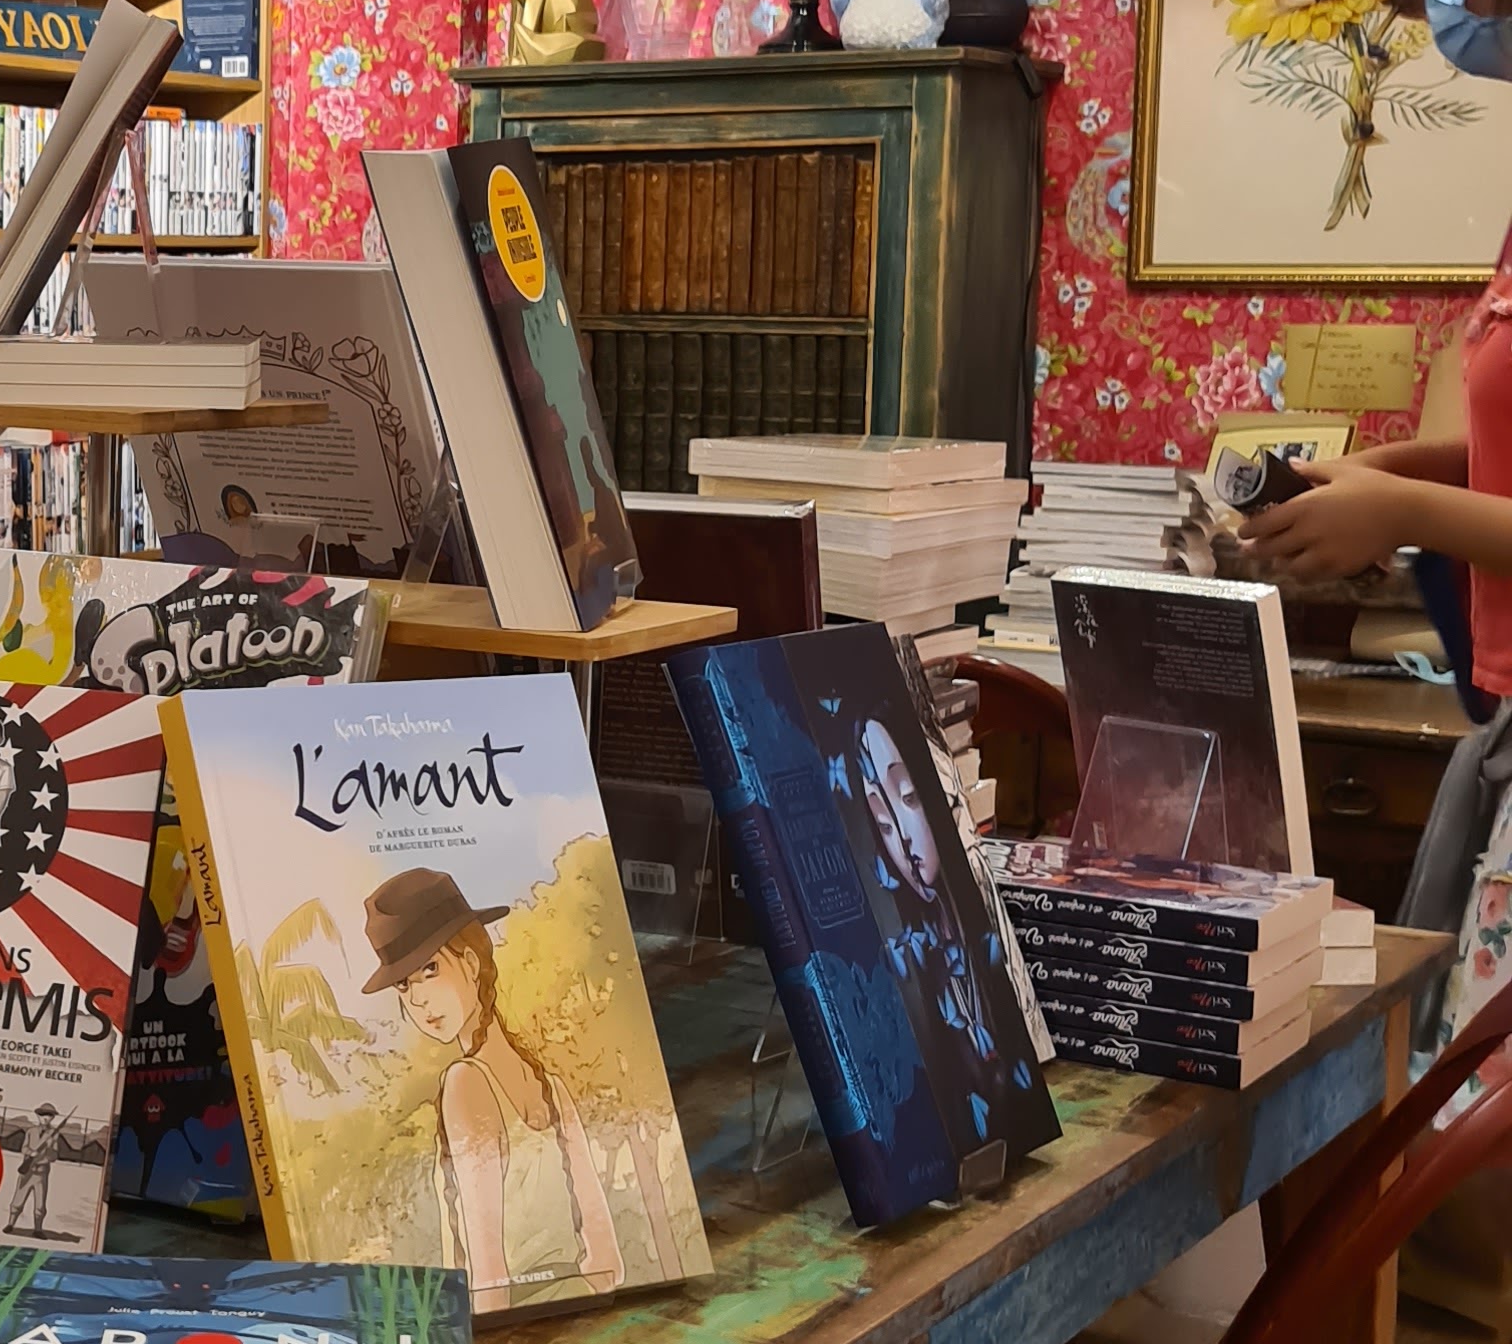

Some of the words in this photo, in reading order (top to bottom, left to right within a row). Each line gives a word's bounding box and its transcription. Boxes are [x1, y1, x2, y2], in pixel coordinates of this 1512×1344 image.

[165, 599, 196, 617] THE
[200, 594, 234, 608] ART
[238, 593, 259, 606] OF
[90, 604, 325, 696] Splatoon
[293, 732, 525, 833] L'amant
[418, 826, 429, 836] LE
[431, 824, 464, 836] ROMAN
[369, 844, 382, 853] DE
[384, 840, 445, 852] MARGUERITE
[447, 836, 477, 847] DURAS
[143, 1019, 164, 1035] UN
[130, 1032, 187, 1051] RTBOOK
[42, 1044, 72, 1059] TAKEI
[44, 1067, 84, 1084] BECKER
